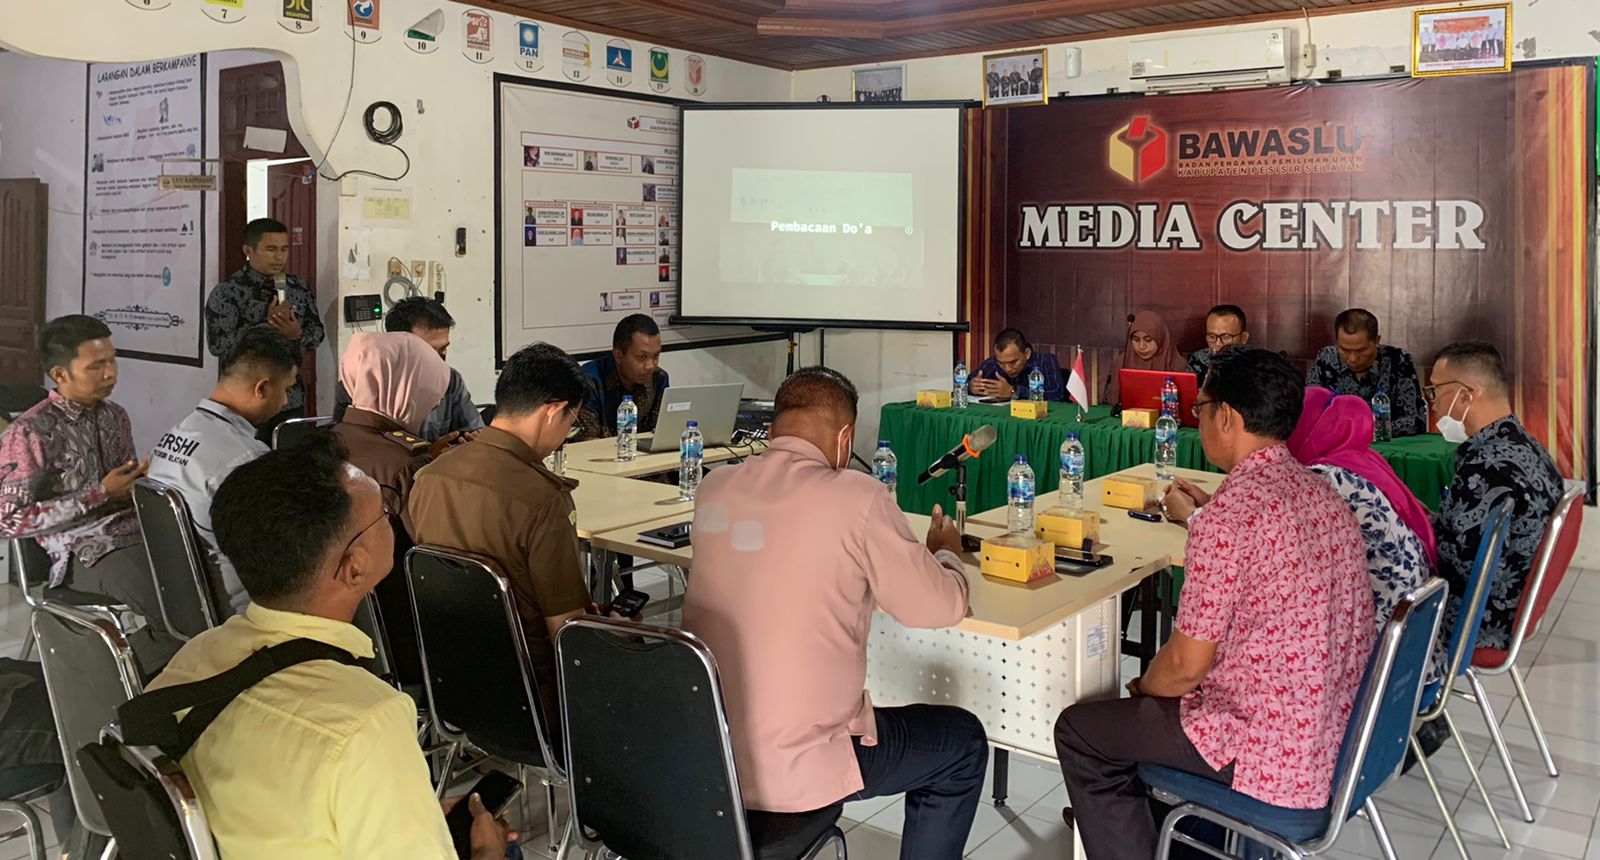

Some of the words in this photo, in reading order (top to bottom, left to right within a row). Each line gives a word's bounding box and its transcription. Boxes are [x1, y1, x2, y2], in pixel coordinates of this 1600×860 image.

[221, 8, 228, 19] 7
[295, 20, 302, 30] 8
[360, 30, 367, 40] 9
[417, 41, 427, 51] 10
[475, 51, 483, 61] 11
[519, 47, 539, 58] PAN
[97, 68, 129, 83] LARANGAN
[129, 64, 152, 78] DALAM
[152, 55, 197, 74] BERKAMPANYE
[525, 60, 534, 69] 12
[1178, 126, 1362, 160] BAWASLU
[1178, 160, 1211, 169] BADAN
[1213, 158, 1269, 167] PENGAWAS
[1271, 156, 1329, 165] PEMILIHAN
[1331, 155, 1363, 164] UMUM
[1177, 167, 1248, 178] KABUPATEN
[1250, 164, 1301, 176] PESISIR
[1303, 162, 1364, 173] SELATAN
[770, 220, 836, 233] Pembacaan
[842, 223, 873, 234] Do'a
[1018, 202, 1201, 250] MEDIA
[1217, 200, 1486, 251] CENTER
